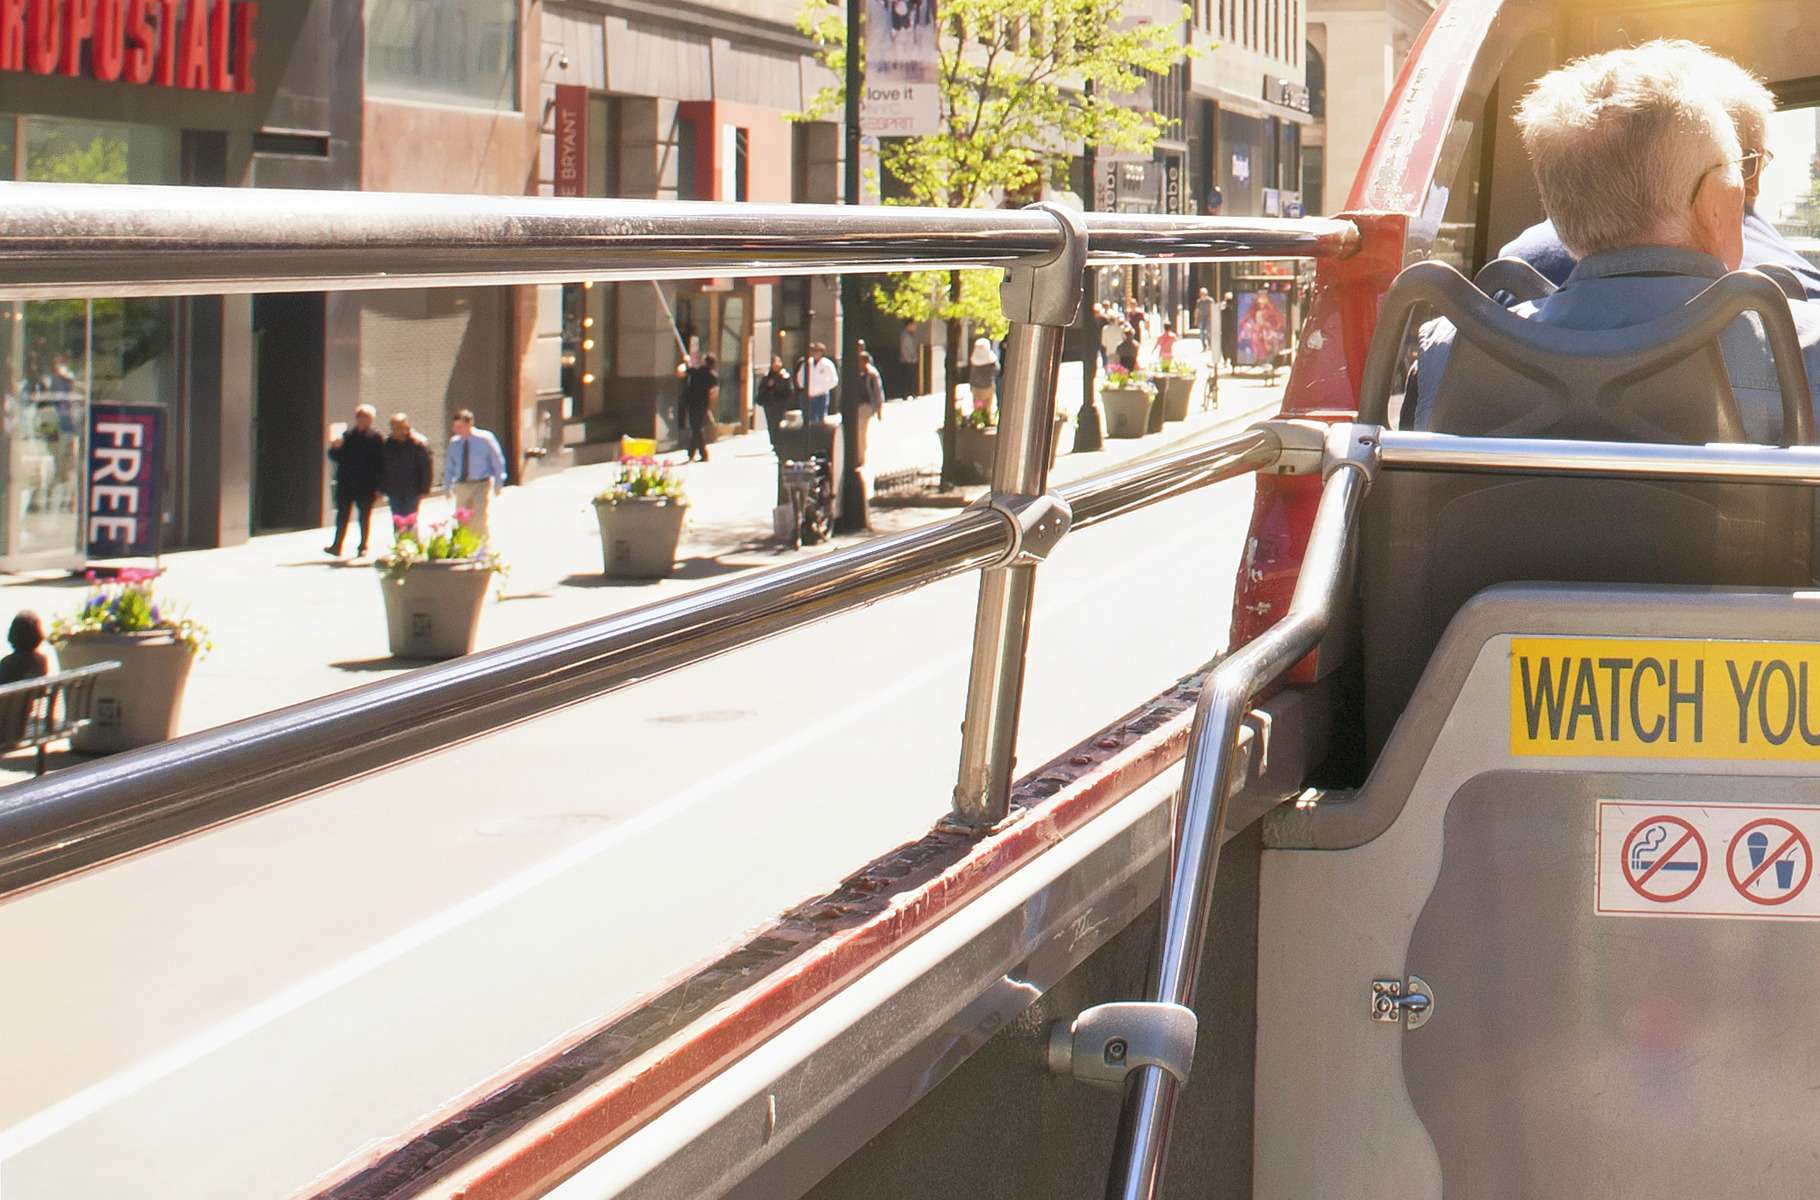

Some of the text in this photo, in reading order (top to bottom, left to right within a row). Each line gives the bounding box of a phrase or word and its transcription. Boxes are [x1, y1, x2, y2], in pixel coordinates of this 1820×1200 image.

[867, 87, 913, 101] love it
[562, 109, 577, 178] BRYANT
[89, 422, 144, 544] FREE
[1519, 655, 1704, 744] WATCH
